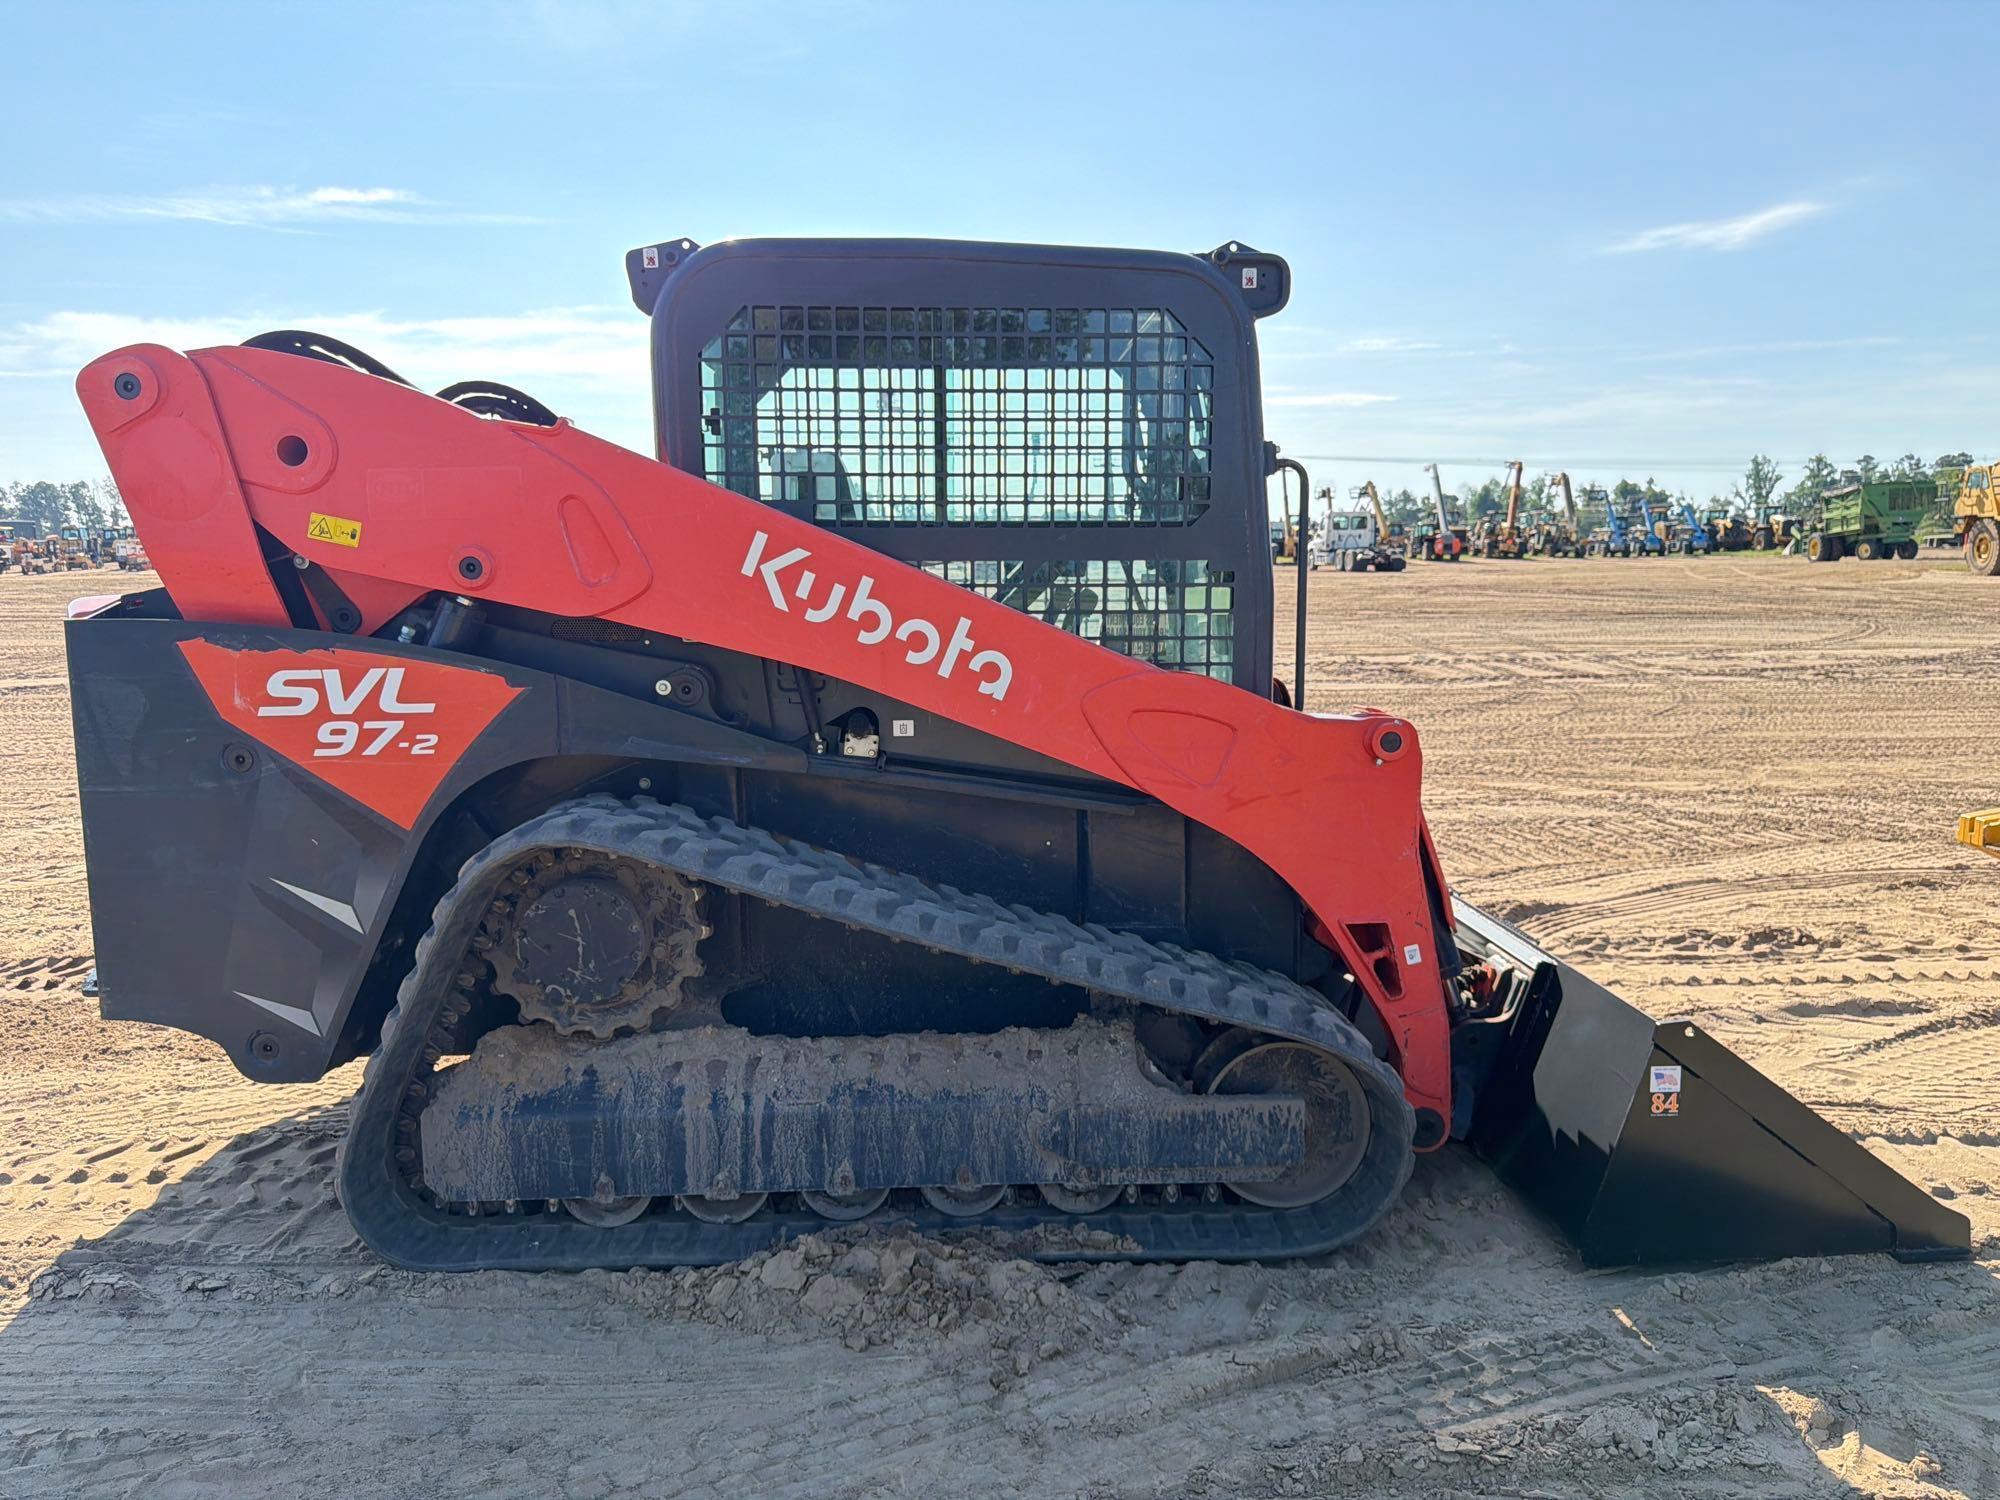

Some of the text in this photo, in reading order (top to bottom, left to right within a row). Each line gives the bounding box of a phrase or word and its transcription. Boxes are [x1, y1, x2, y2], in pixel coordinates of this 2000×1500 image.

[741, 530, 1013, 701] Kubota
[257, 667, 436, 717] SVL
[313, 720, 439, 757] 97-2
[1651, 1092, 1679, 1113] 84
